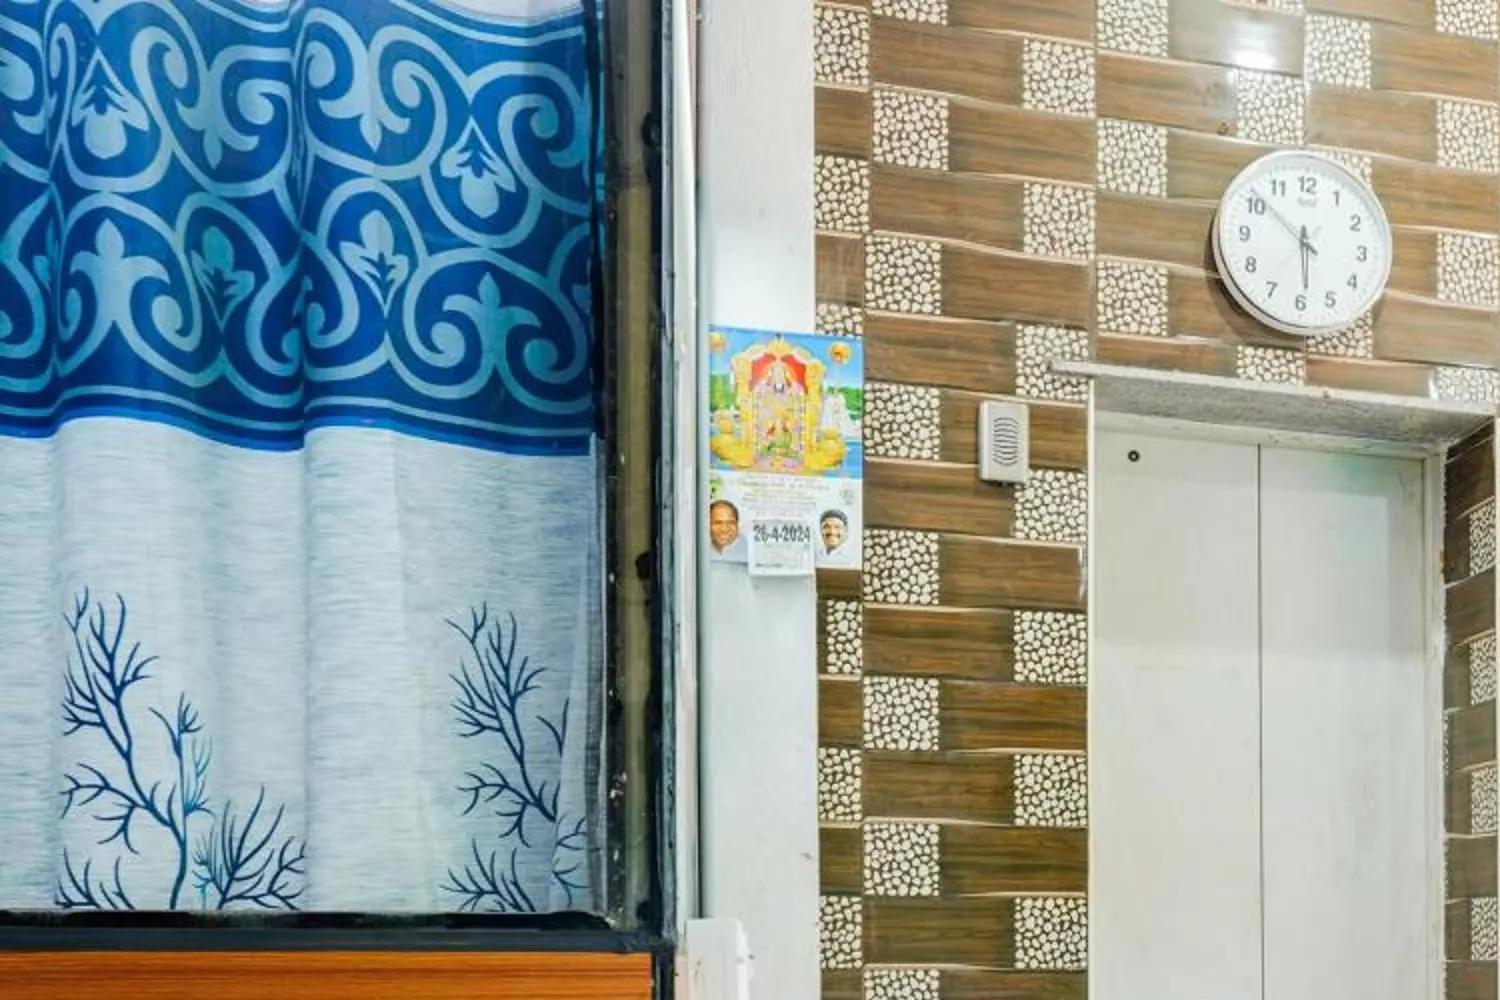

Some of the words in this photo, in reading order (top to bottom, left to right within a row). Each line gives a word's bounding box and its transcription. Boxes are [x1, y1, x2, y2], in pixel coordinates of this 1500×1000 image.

[1271, 179, 1287, 197] 11
[1297, 175, 1317, 195] 12
[1247, 197, 1266, 216] 10
[1332, 190, 1341, 207] 1
[1349, 214, 1362, 233] 2
[1239, 225, 1251, 242] 9
[1356, 245, 1368, 263] 3
[1245, 256, 1257, 274] 8
[1266, 280, 1278, 298] 7
[1347, 274, 1358, 291] 4
[1295, 294, 1308, 312] 6
[1324, 291, 1337, 309] 5
